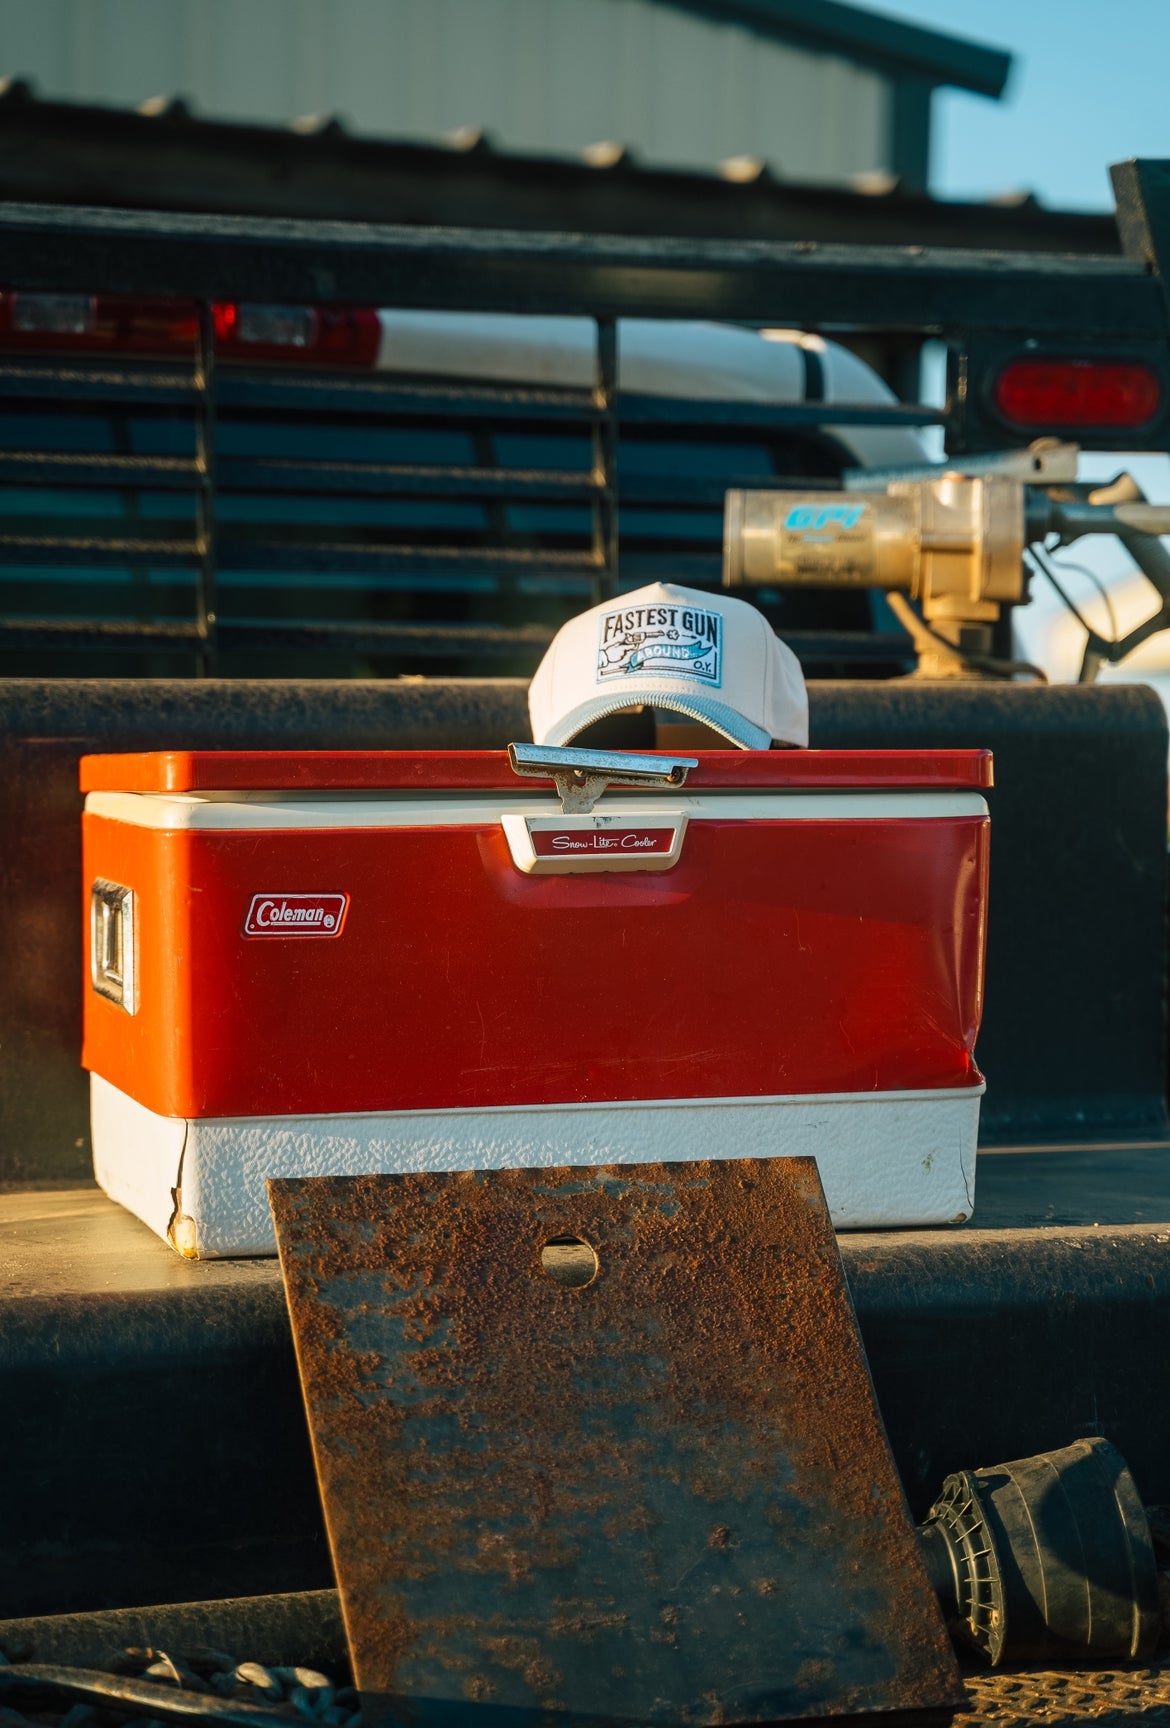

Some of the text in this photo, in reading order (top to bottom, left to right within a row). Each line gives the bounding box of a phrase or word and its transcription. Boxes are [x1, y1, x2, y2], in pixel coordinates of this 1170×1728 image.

[604, 608, 718, 648] FASTEST GUN
[636, 645, 690, 661] AROUND
[693, 660, 712, 673] O.Y.
[621, 834, 657, 848] Cooler
[256, 901, 324, 926] Coleman
